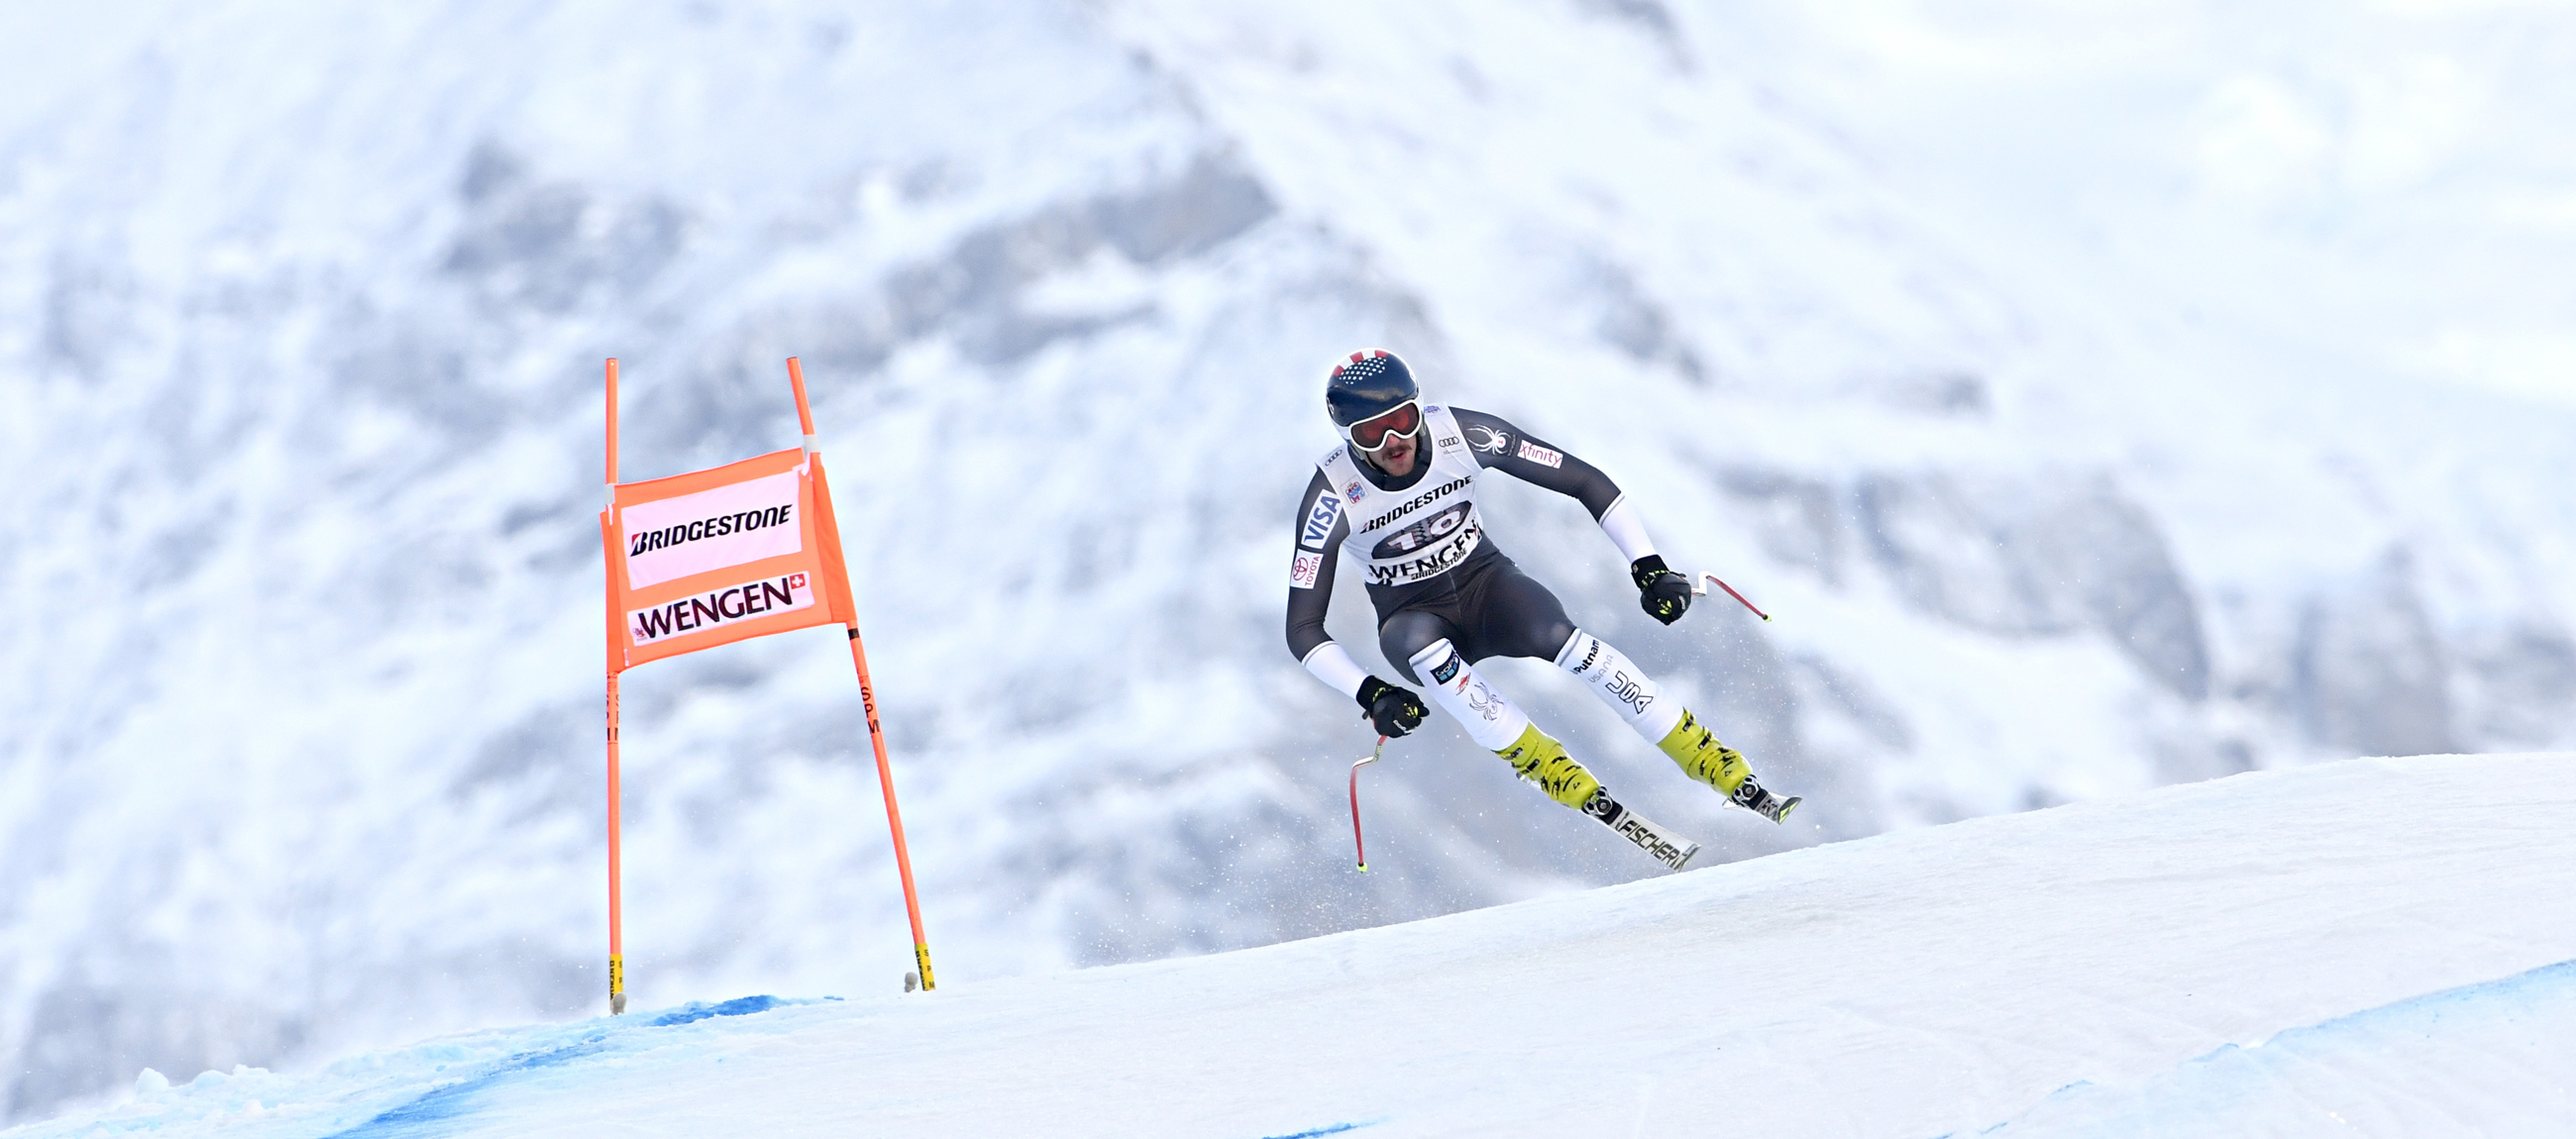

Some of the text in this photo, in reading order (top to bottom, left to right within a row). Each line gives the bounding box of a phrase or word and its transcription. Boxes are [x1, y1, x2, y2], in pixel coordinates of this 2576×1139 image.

[1519, 443, 1562, 467] xfinity
[1303, 495, 1341, 543] VISA
[1359, 475, 1473, 534] BRIDGESTONE
[630, 503, 793, 557] BRIDGESTONE
[1305, 556, 1320, 586] TOYOTA
[1411, 548, 1467, 580] BRIDGESTONE
[638, 577, 793, 639] WENGEN
[1587, 654, 1614, 683] USANA
[1605, 670, 1654, 715] USA
[1618, 819, 1681, 866] FISCHER
